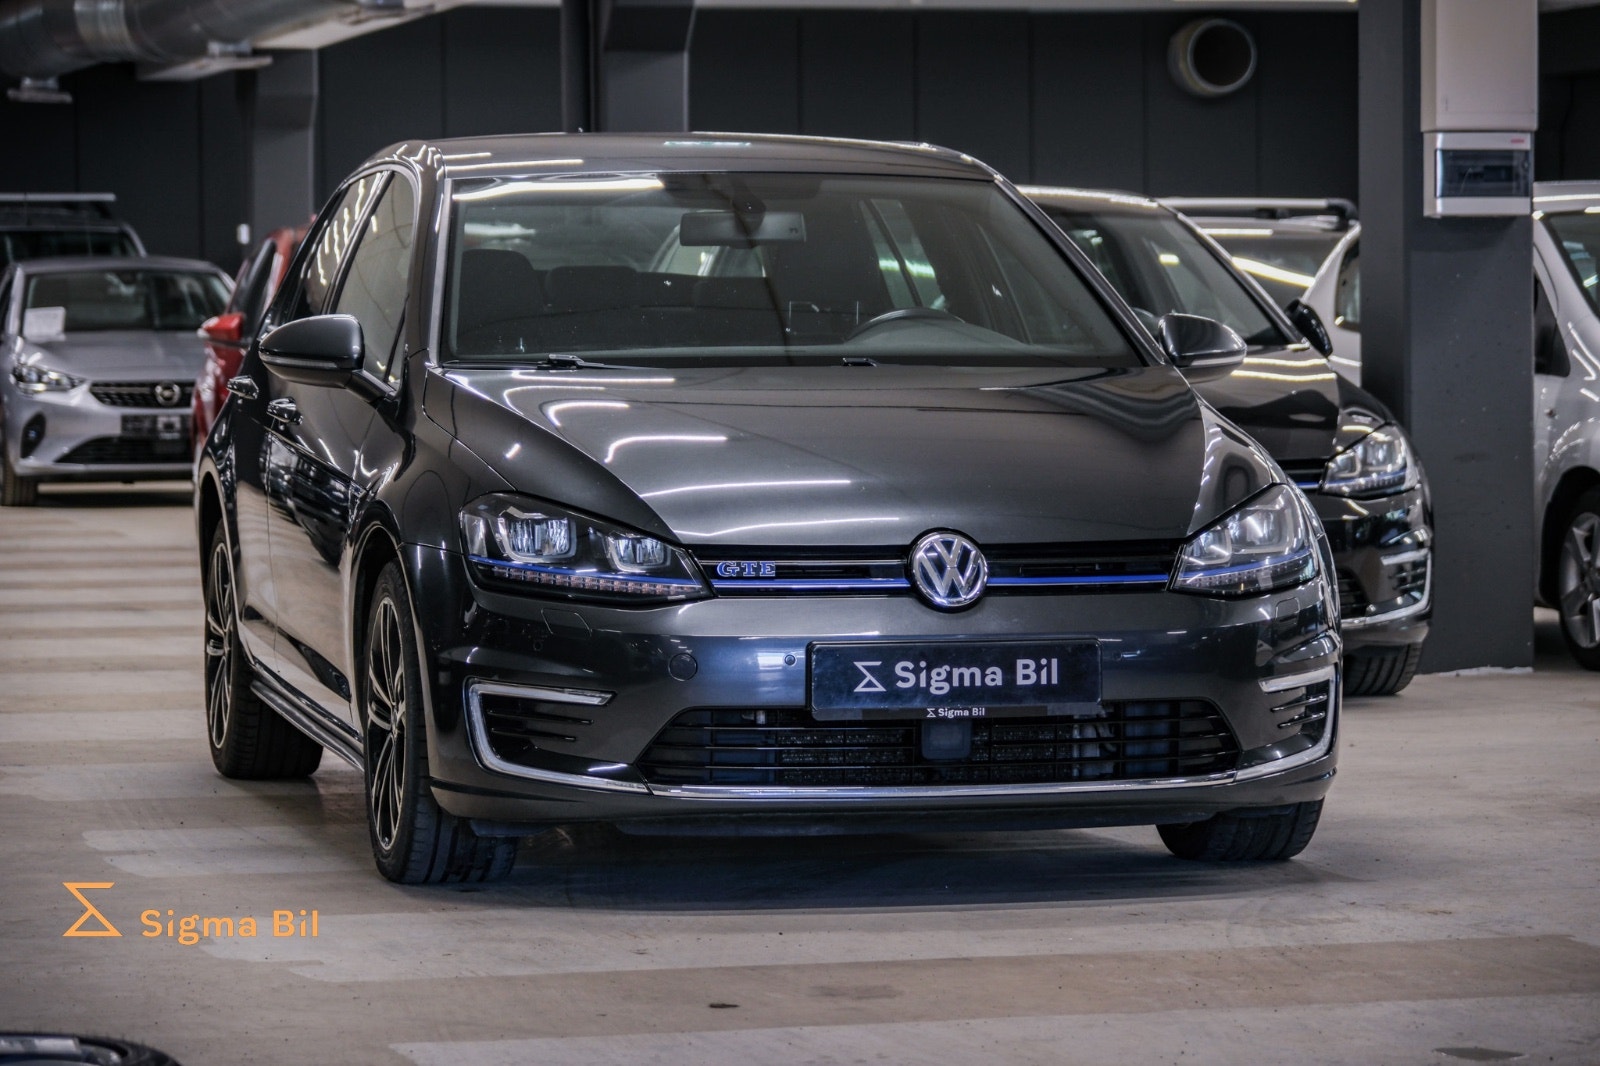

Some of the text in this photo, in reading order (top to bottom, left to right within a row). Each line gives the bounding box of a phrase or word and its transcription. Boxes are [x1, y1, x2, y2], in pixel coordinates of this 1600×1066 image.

[716, 561, 776, 577] GTE
[913, 533, 986, 606] VW
[894, 658, 1059, 695] Sigma Bil
[937, 707, 986, 718] Sigma Bil
